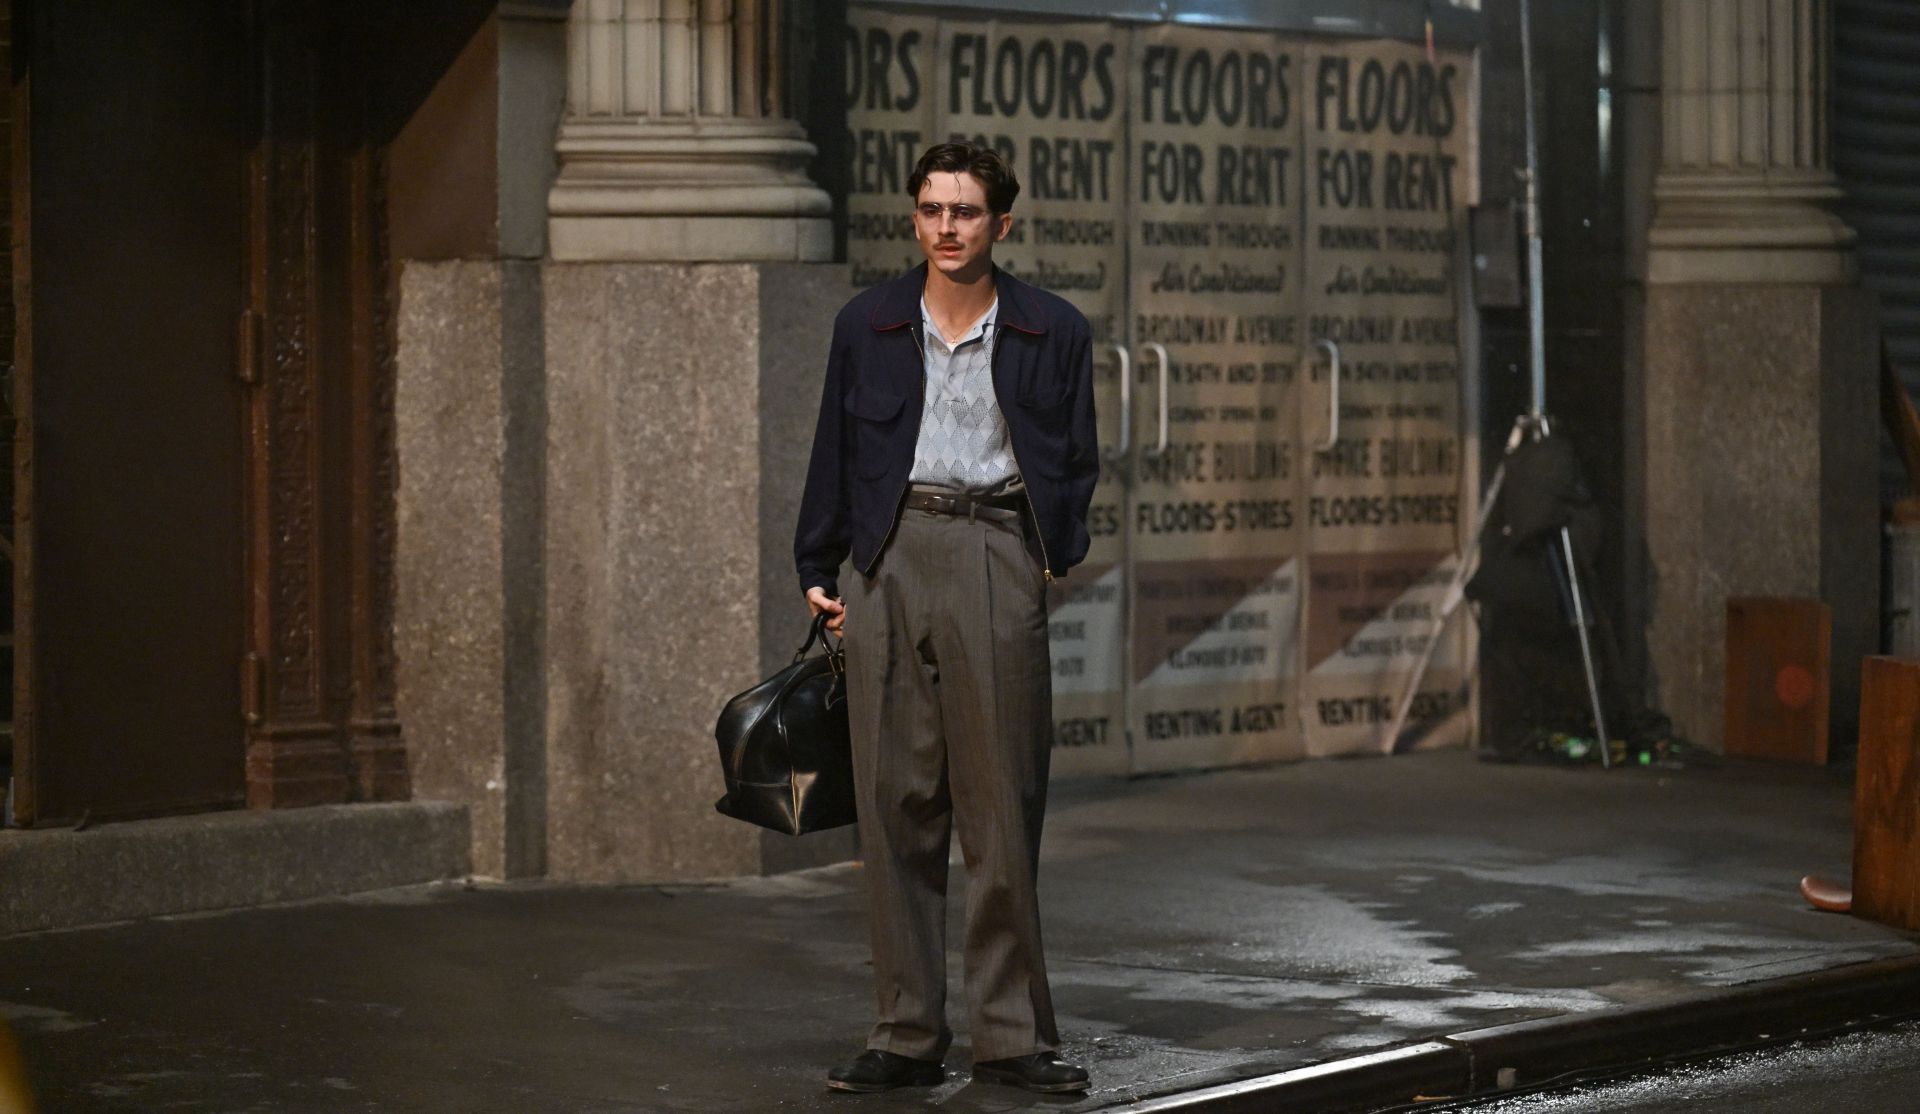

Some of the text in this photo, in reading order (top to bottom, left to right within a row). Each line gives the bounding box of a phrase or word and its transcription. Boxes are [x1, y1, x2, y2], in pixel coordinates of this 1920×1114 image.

[949, 33, 1115, 121] FLOORS
[1141, 46, 1291, 129] FLOORS
[1315, 56, 1456, 138] FLOORS
[1030, 136, 1114, 201] RENT
[1141, 141, 1291, 208] FOR RENT
[1316, 148, 1456, 213] FOR RENT
[1033, 217, 1114, 246] THROUGH
[1145, 703, 1285, 741] RENTING AGENT
[1317, 695, 1391, 727] RENTING
